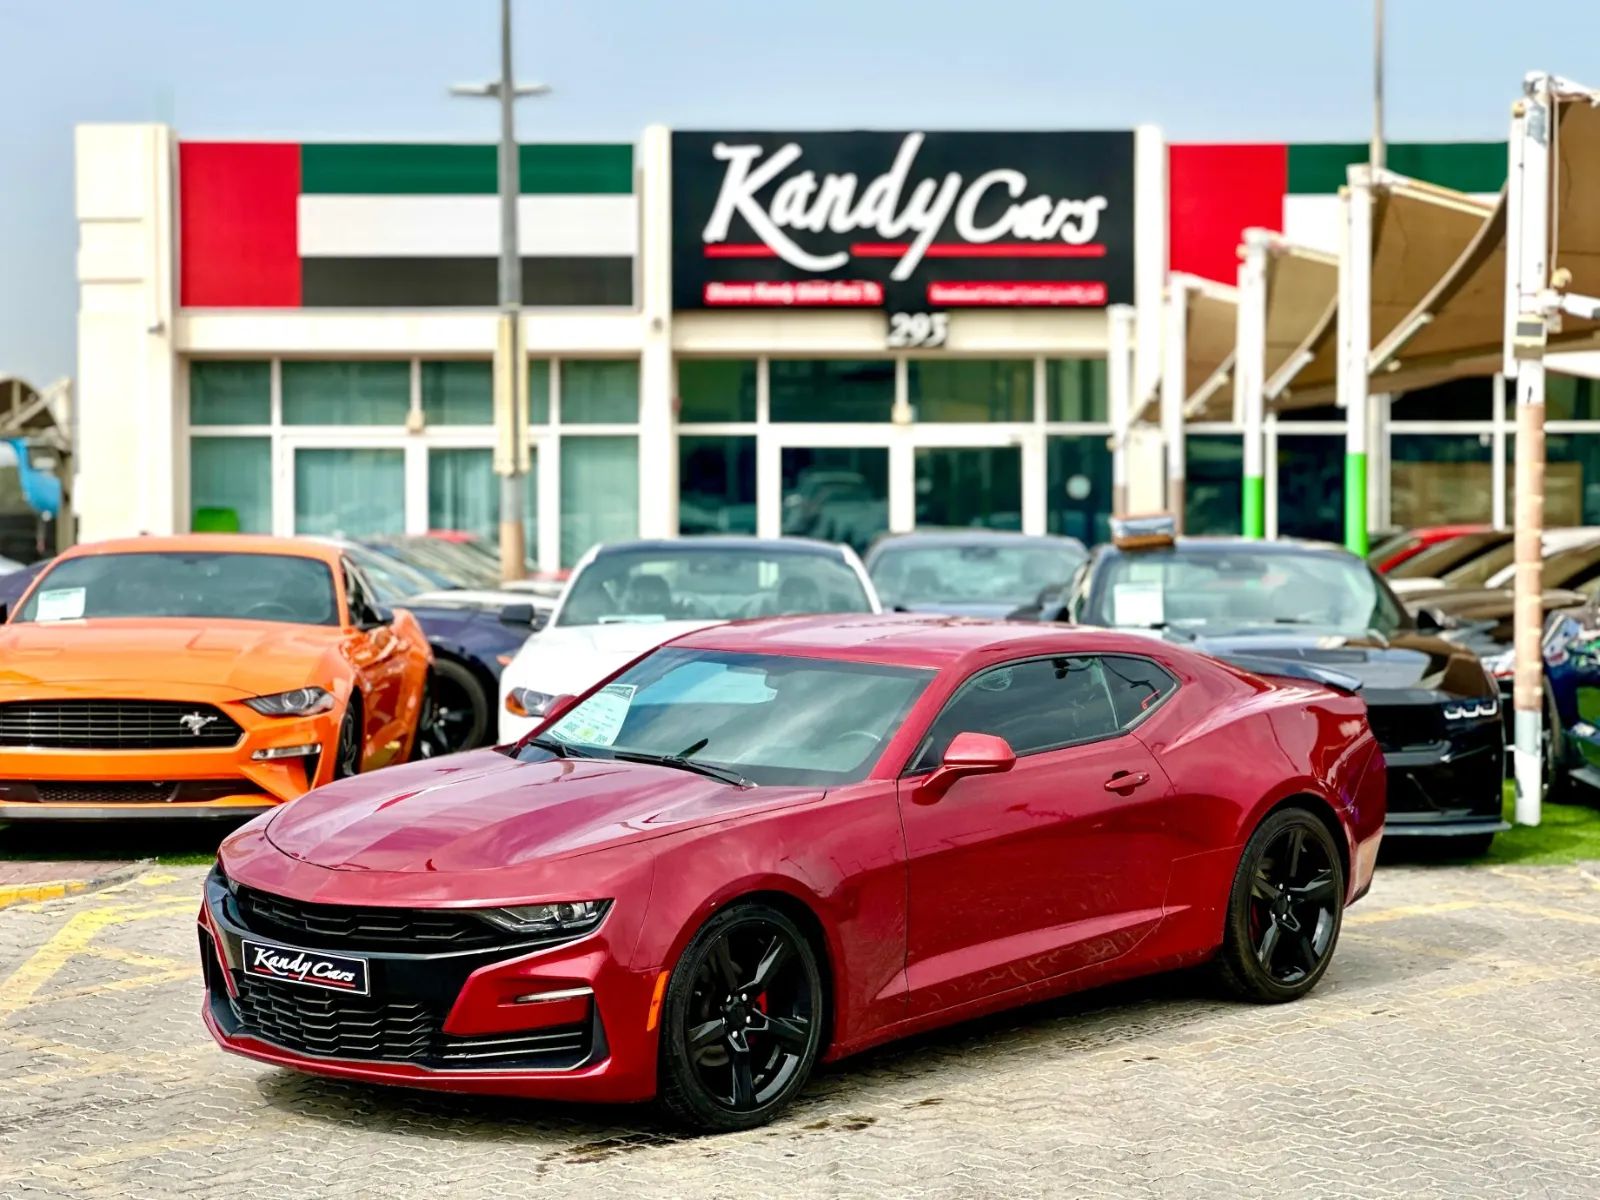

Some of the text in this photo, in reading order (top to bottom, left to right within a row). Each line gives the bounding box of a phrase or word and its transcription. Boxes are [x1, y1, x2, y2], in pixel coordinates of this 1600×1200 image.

[703, 132, 1107, 280] Kandy Cars
[887, 312, 949, 347] 295
[254, 947, 355, 981] Kandy Cars
